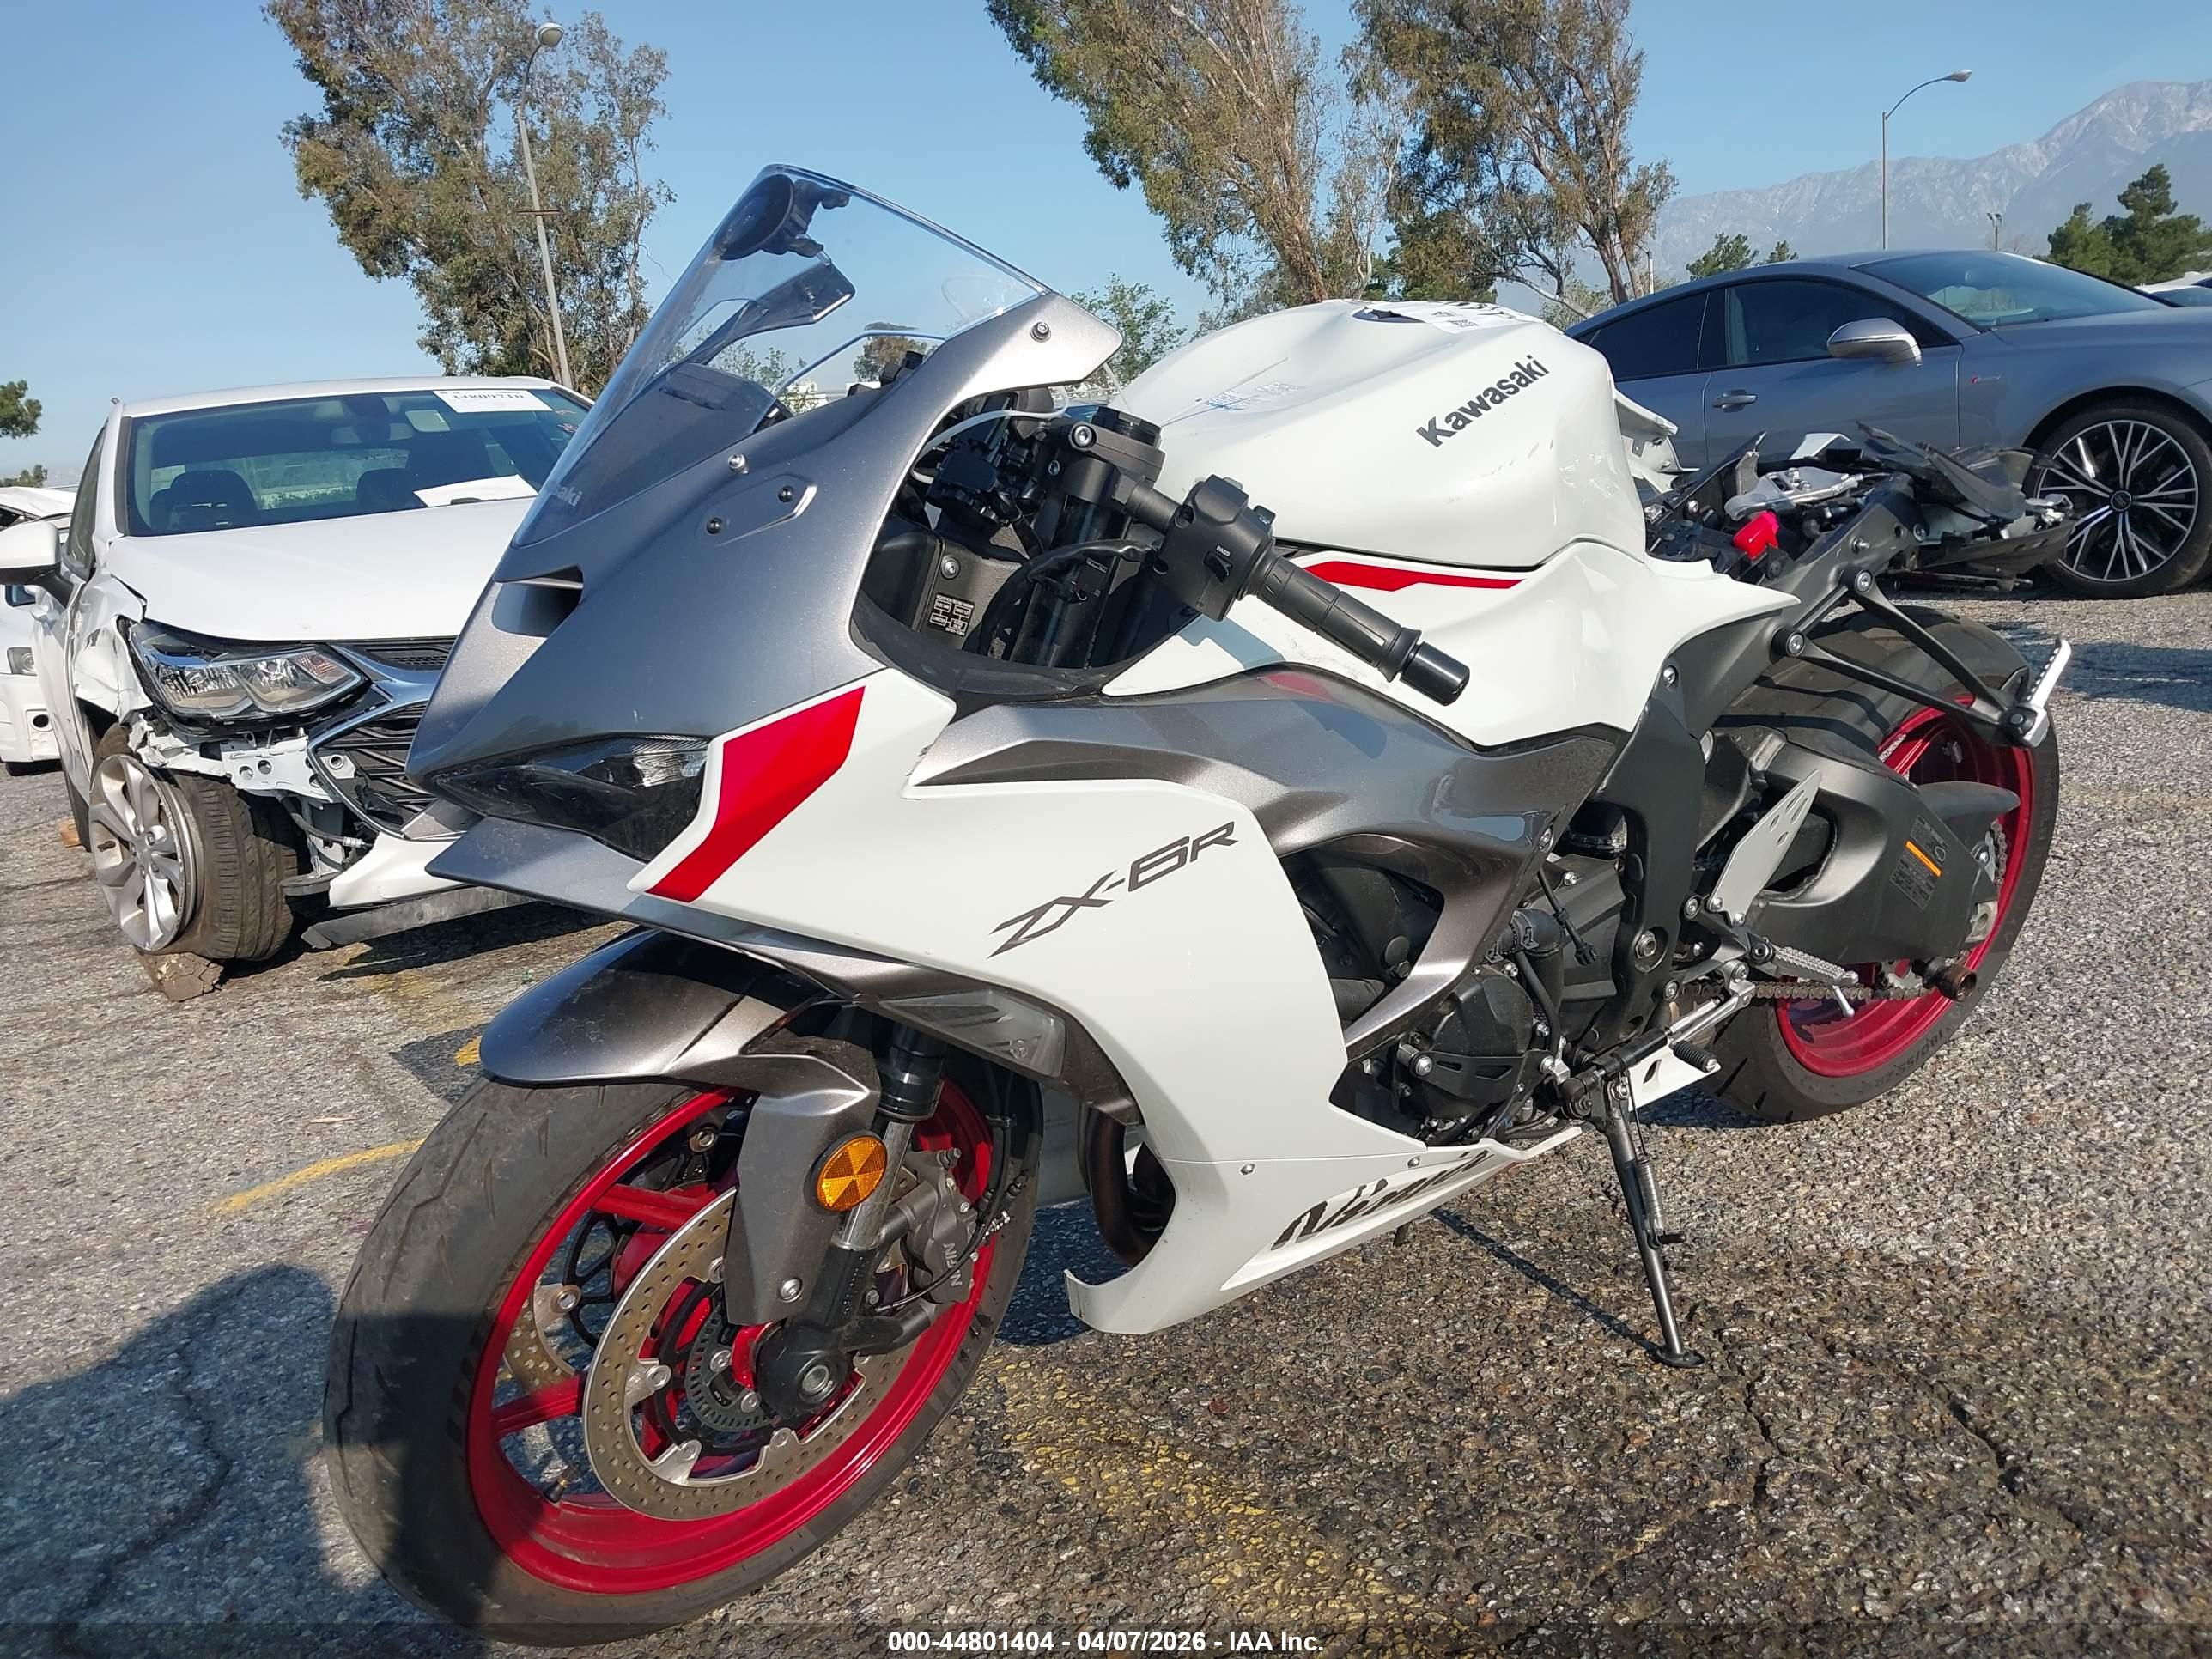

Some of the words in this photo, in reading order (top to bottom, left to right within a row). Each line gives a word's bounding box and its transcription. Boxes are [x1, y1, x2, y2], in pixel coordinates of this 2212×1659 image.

[1416, 354, 1550, 447] Kawasaki
[985, 820, 1239, 960] ZX-6R
[1271, 1149, 1495, 1251] Ninja
